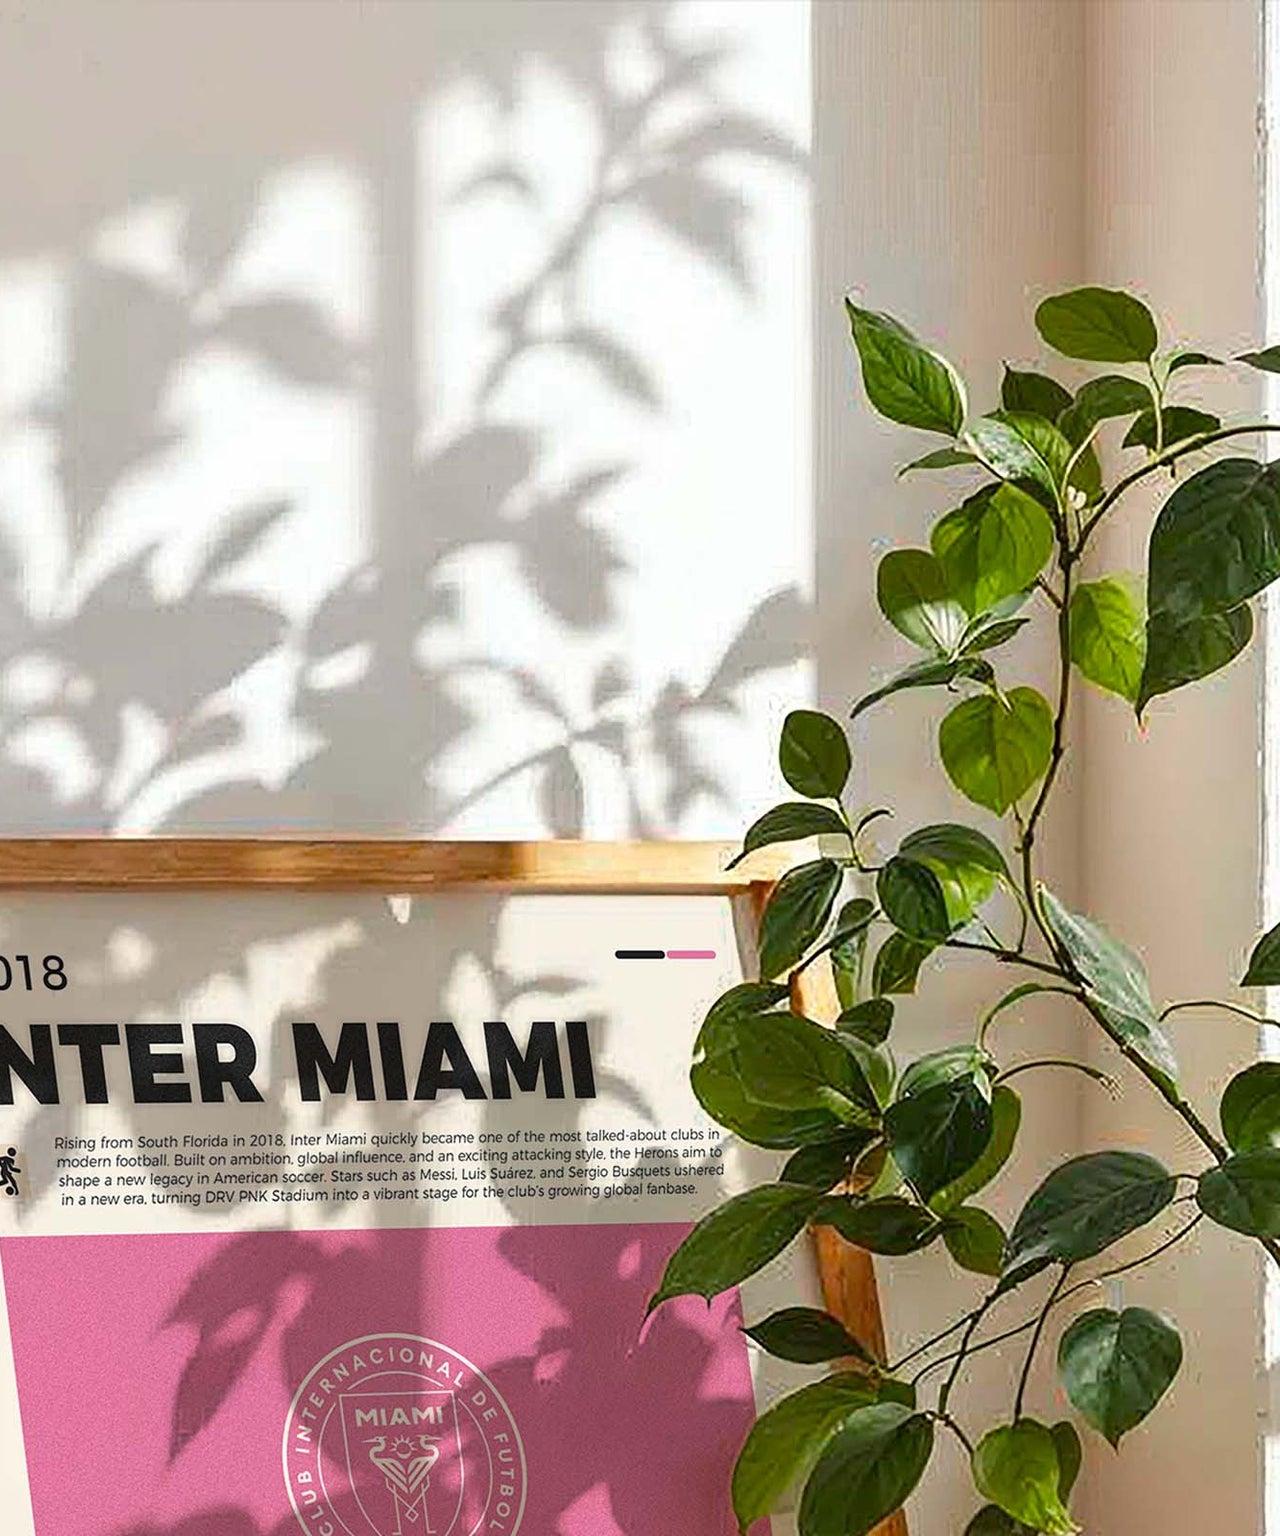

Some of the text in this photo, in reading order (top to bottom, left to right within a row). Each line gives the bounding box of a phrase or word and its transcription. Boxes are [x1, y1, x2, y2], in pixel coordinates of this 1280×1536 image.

[290, 1020, 597, 1102] MIAMI
[150, 1186, 420, 1208] turning DRV PNK Stadium into a vibrant
[295, 1346, 465, 1454] INTERNACIONAL
[471, 1390, 497, 1422] DE
[491, 1432, 515, 1530] FUTBOL
[355, 1406, 443, 1427] MIAMI
